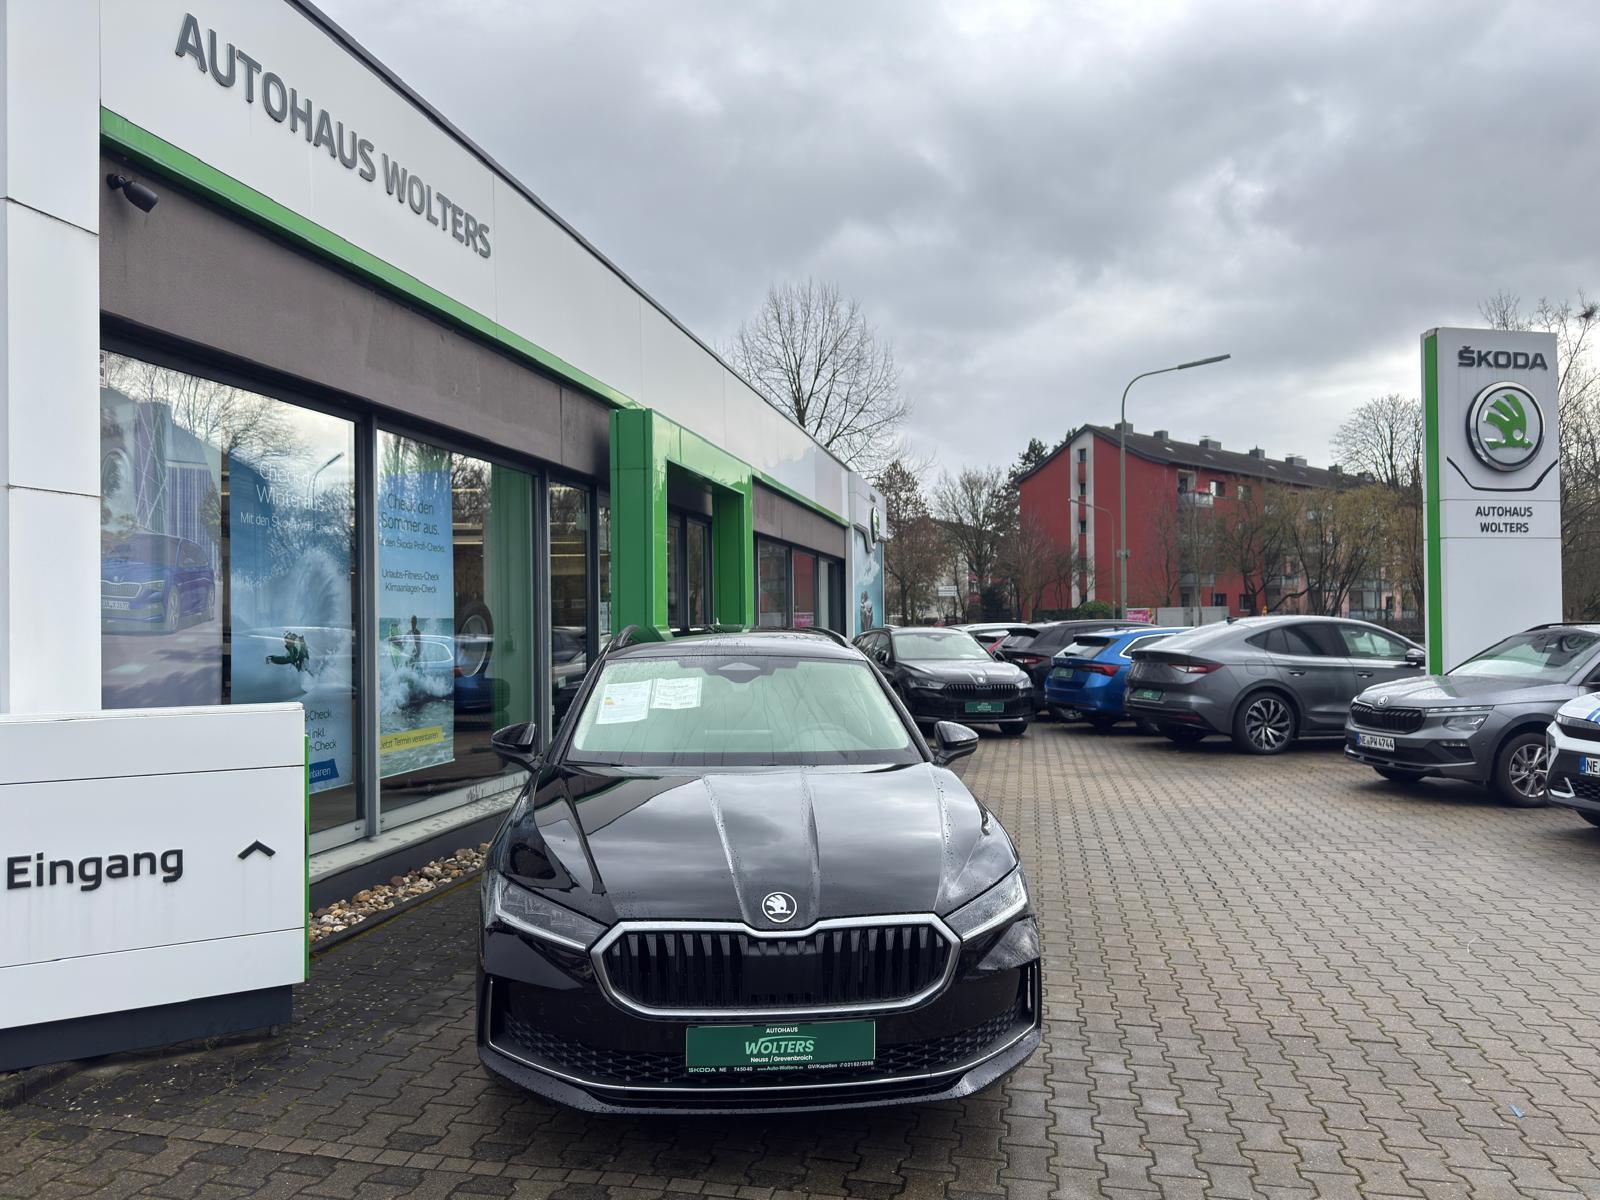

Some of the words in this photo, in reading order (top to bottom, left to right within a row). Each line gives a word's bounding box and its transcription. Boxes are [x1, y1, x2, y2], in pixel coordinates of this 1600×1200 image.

[175, 12, 377, 183] AUTOHAUS
[381, 152, 492, 259] WOLTERS
[1457, 345, 1549, 371] ŠKODA
[387, 493, 416, 513] Check
[417, 501, 435, 515] den
[1475, 505, 1534, 518] AUTOHAUS
[240, 511, 255, 525] Mit
[256, 513, 270, 527] den
[381, 511, 421, 533] Sommer
[423, 521, 440, 536] aus.
[1479, 521, 1530, 534] WOLTERS
[1586, 760, 1598, 773] NE
[7, 849, 184, 891] Eingang
[765, 1026, 799, 1034] AUTOHAUS
[745, 1038, 815, 1055] WOLTERS
[774, 1054, 813, 1062] Grevenbroich
